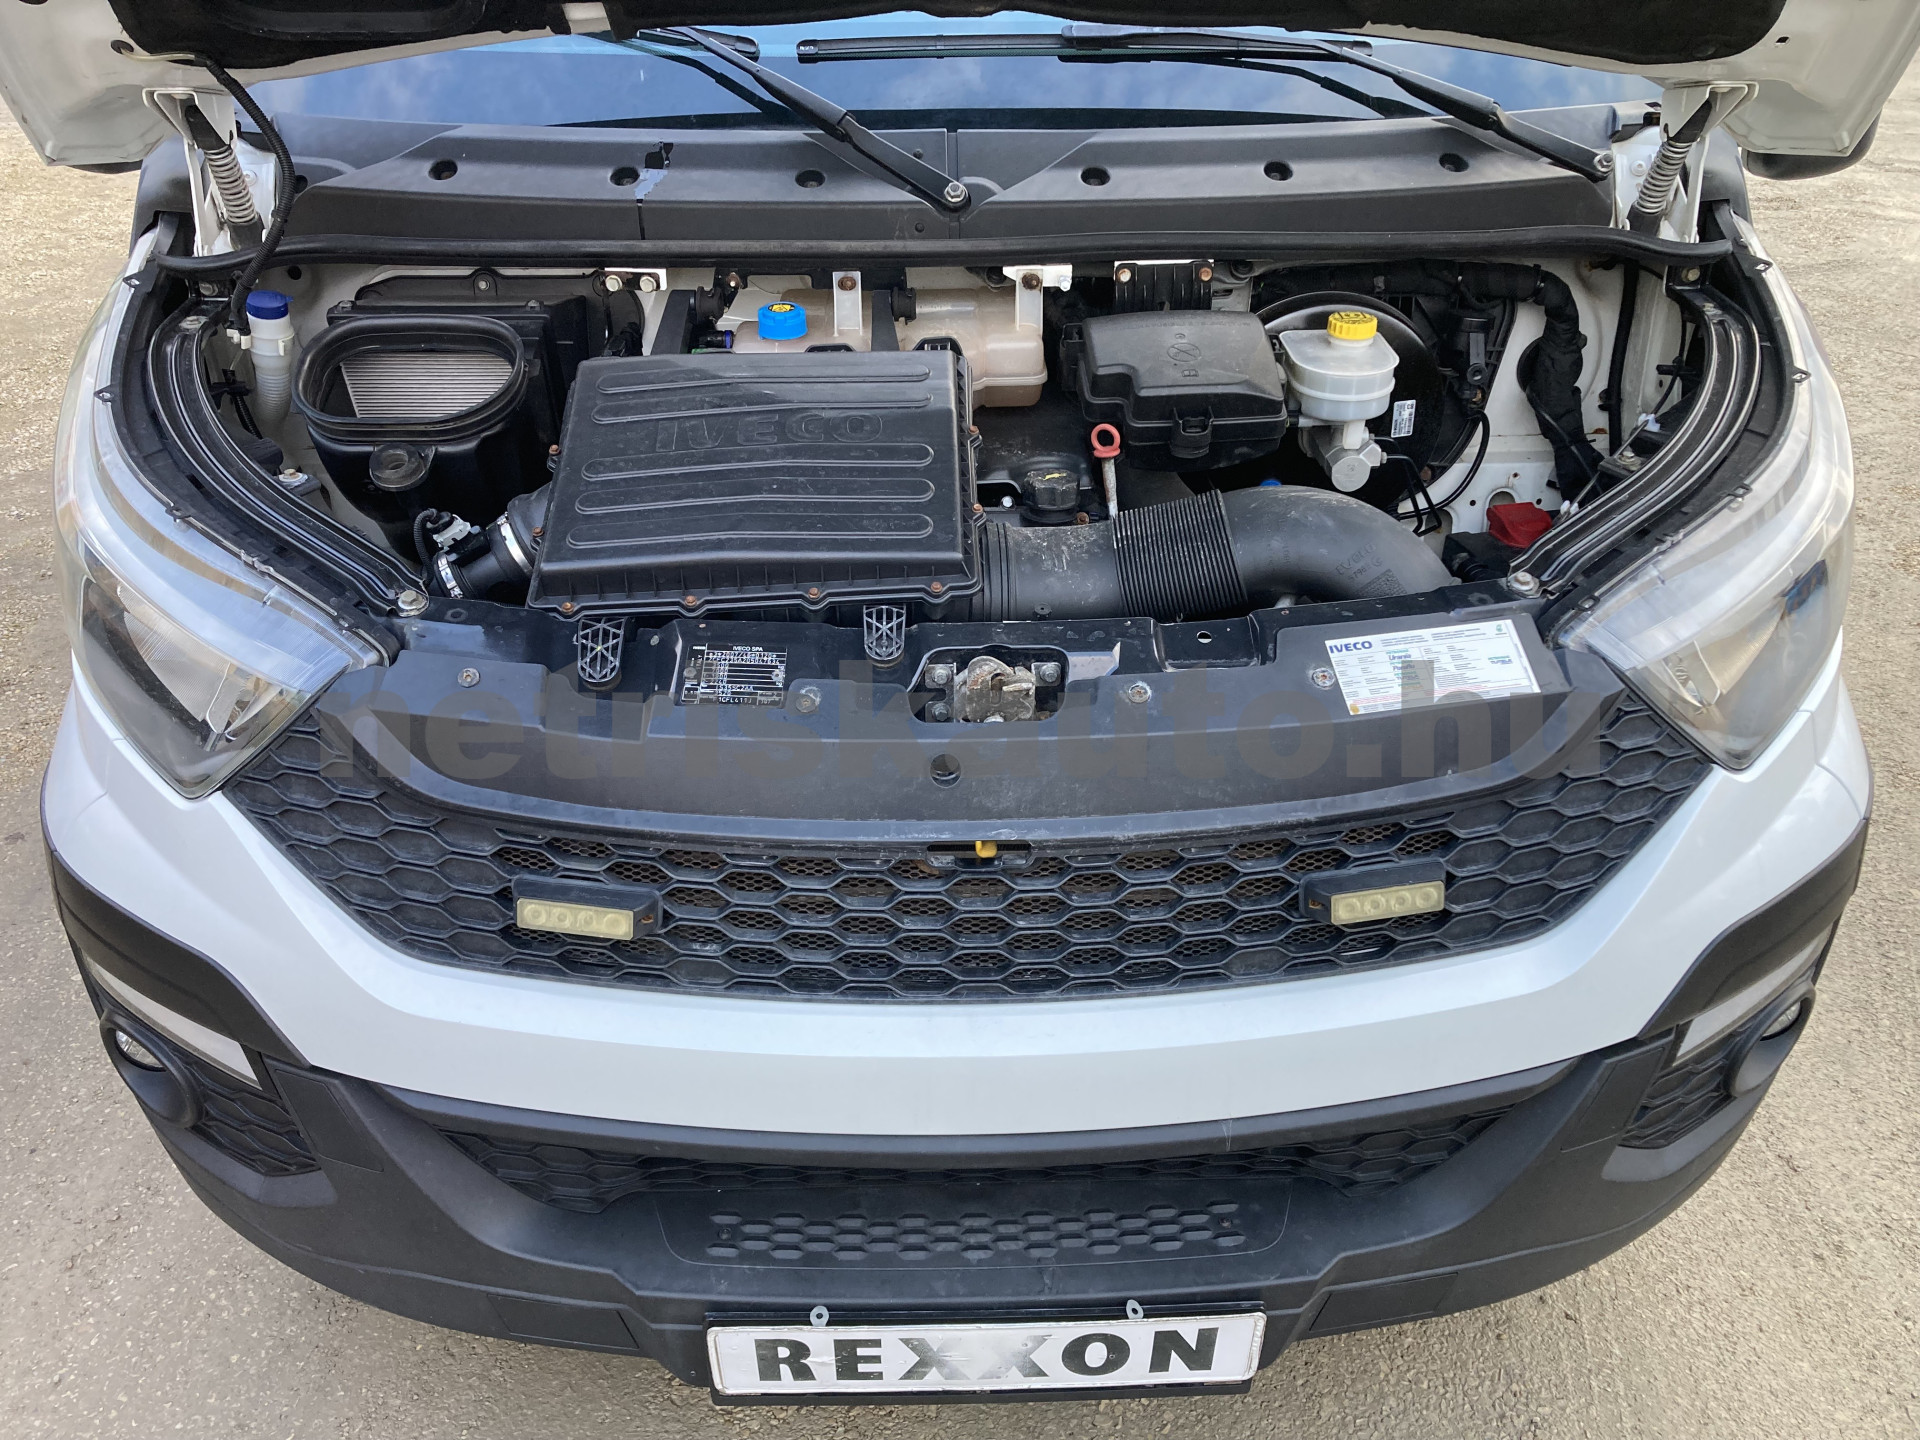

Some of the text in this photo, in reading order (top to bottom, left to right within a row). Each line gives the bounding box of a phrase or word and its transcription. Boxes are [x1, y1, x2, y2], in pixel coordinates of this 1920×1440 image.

[655, 410, 883, 453] IVECO
[1328, 640, 1373, 654] IVECO
[753, 1326, 1220, 1382] REXXON
